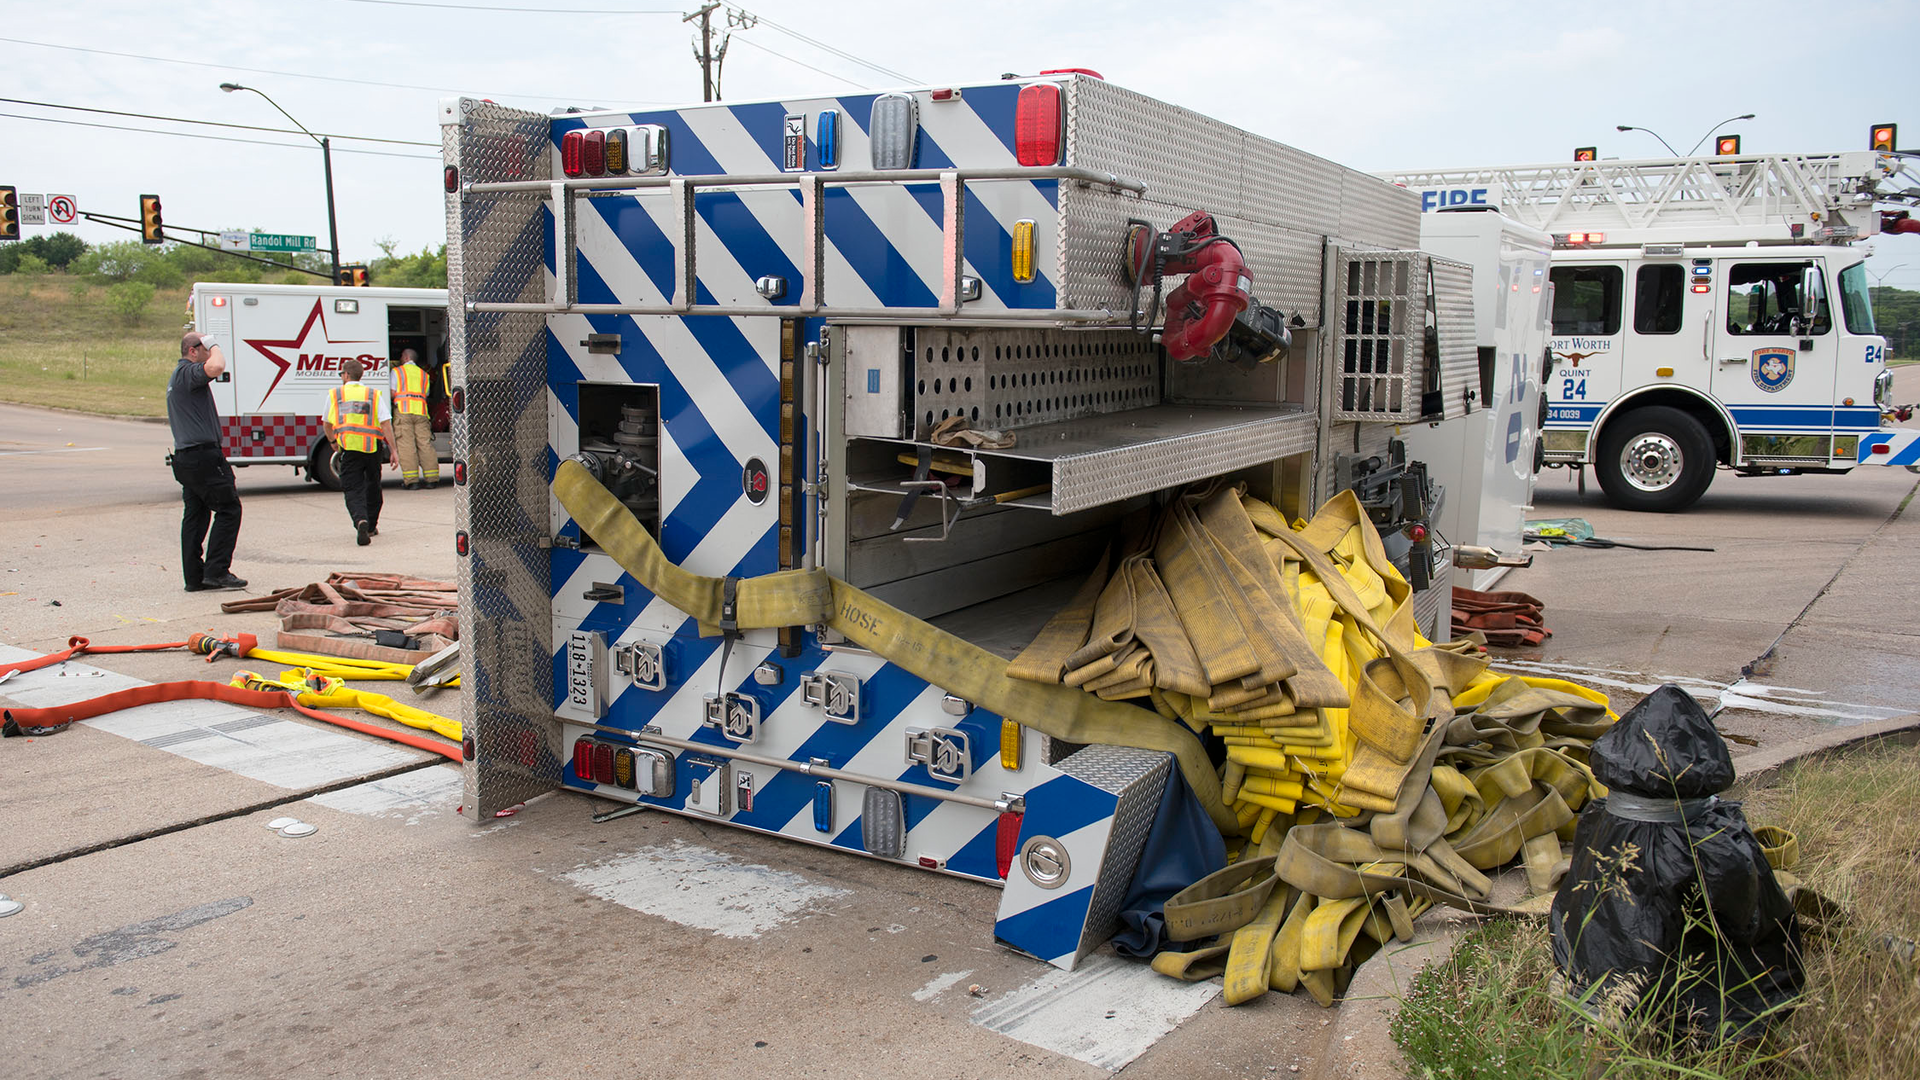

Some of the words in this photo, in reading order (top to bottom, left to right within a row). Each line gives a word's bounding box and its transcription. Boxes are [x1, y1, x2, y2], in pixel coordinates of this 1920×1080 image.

[251, 234, 282, 246] Randol
[285, 236, 301, 248] Mill
[304, 237, 315, 248] Rd
[1550, 340, 1570, 350] ORT
[1572, 338, 1611, 350] WORTH
[1865, 345, 1882, 363] 24
[1559, 369, 1591, 377] QUINT
[1563, 378, 1586, 400] 24
[1560, 409, 1580, 419] 0039
[840, 601, 884, 636] HOSE
